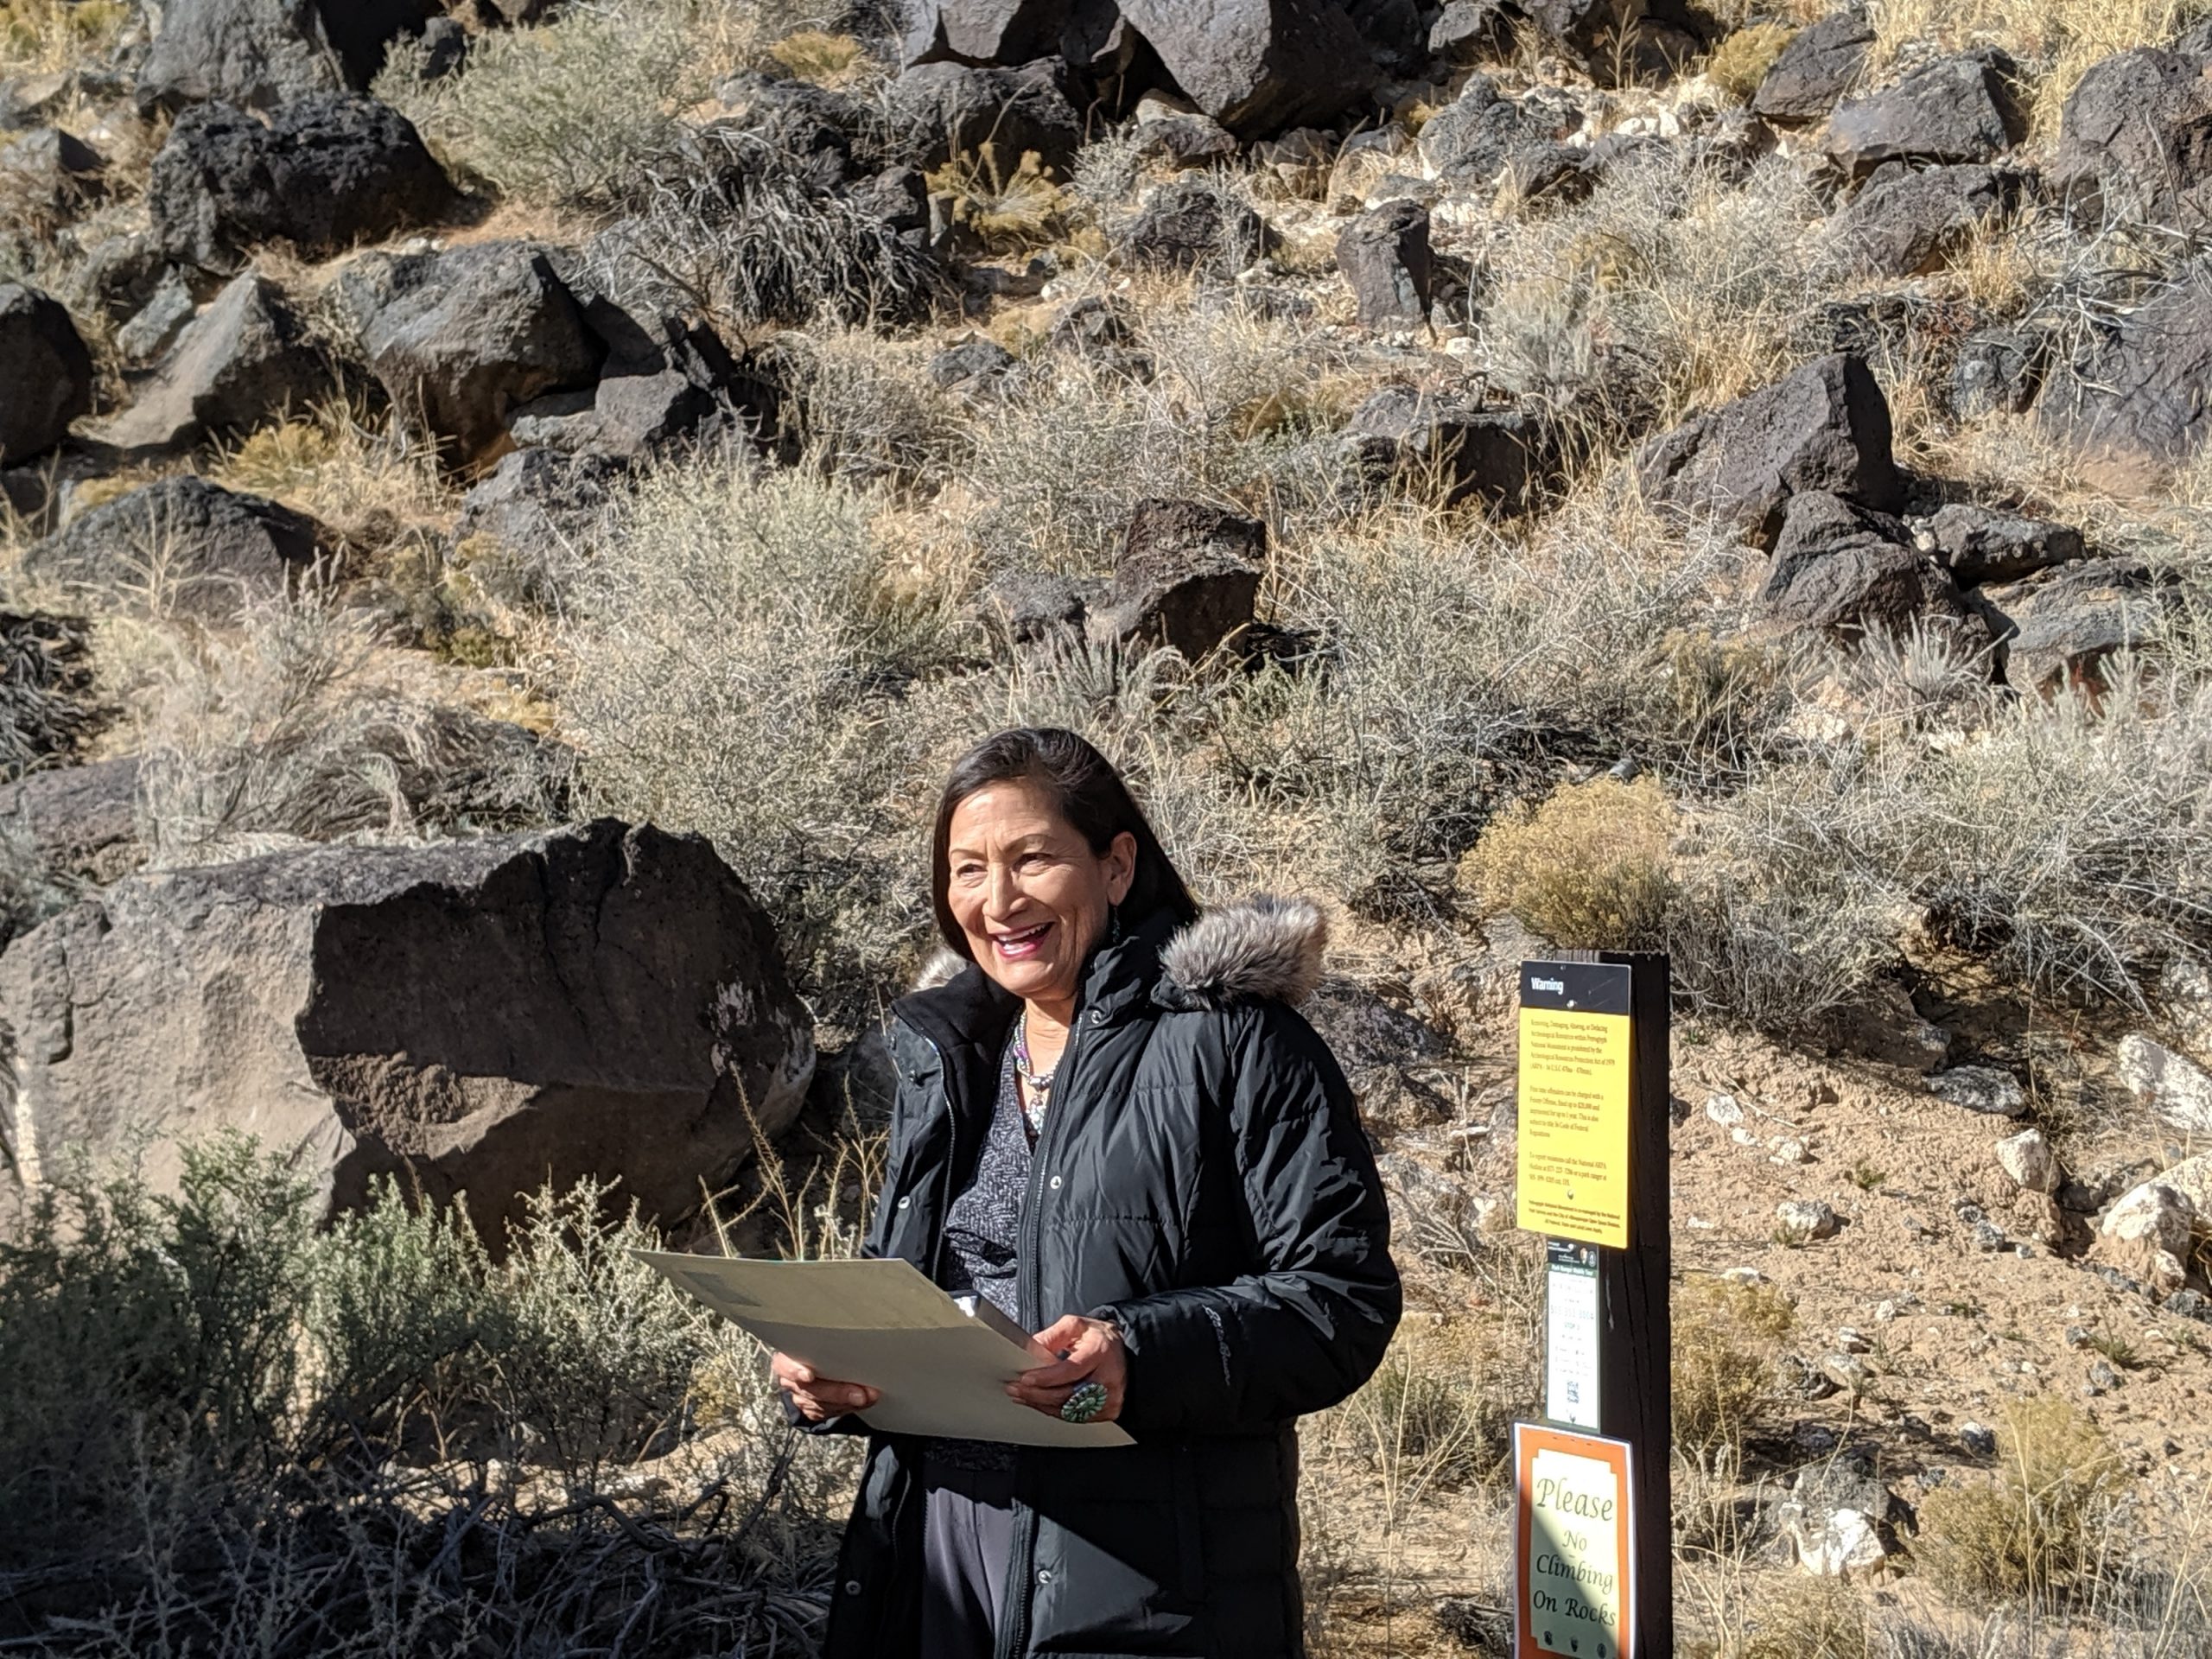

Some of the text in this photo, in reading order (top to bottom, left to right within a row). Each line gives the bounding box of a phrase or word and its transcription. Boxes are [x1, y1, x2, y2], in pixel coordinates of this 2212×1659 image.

[1531, 977, 1564, 995] Warning
[1536, 1478, 1612, 1522] Please
[1562, 1529, 1587, 1551] No
[1536, 1554, 1613, 1595] Climbing
[1534, 1590, 1616, 1626] On Rocks
